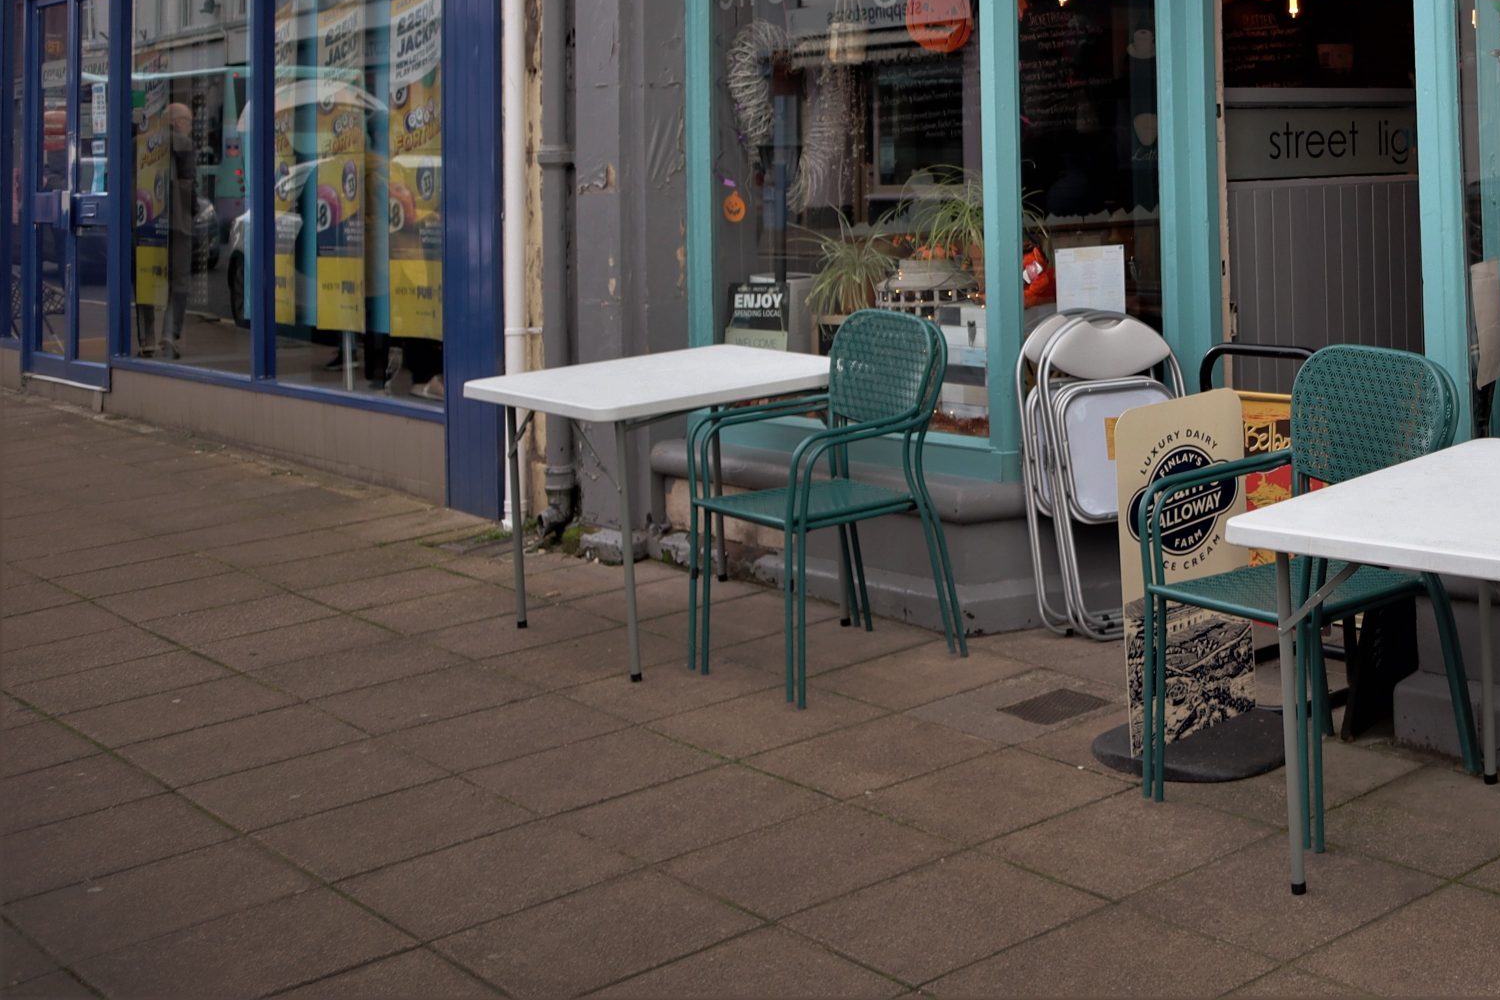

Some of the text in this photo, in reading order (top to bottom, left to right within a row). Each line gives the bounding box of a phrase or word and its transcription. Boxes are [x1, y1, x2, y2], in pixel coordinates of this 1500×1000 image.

[1269, 119, 1417, 165] street lig
[734, 293, 783, 309] ENJOY
[762, 309, 781, 318] LOCAL
[1140, 428, 1219, 476] LUXURY DAIRY
[1160, 452, 1203, 478] FINLAY'S
[1174, 528, 1203, 548] FARM
[1162, 534, 1221, 571] CE CREAM
